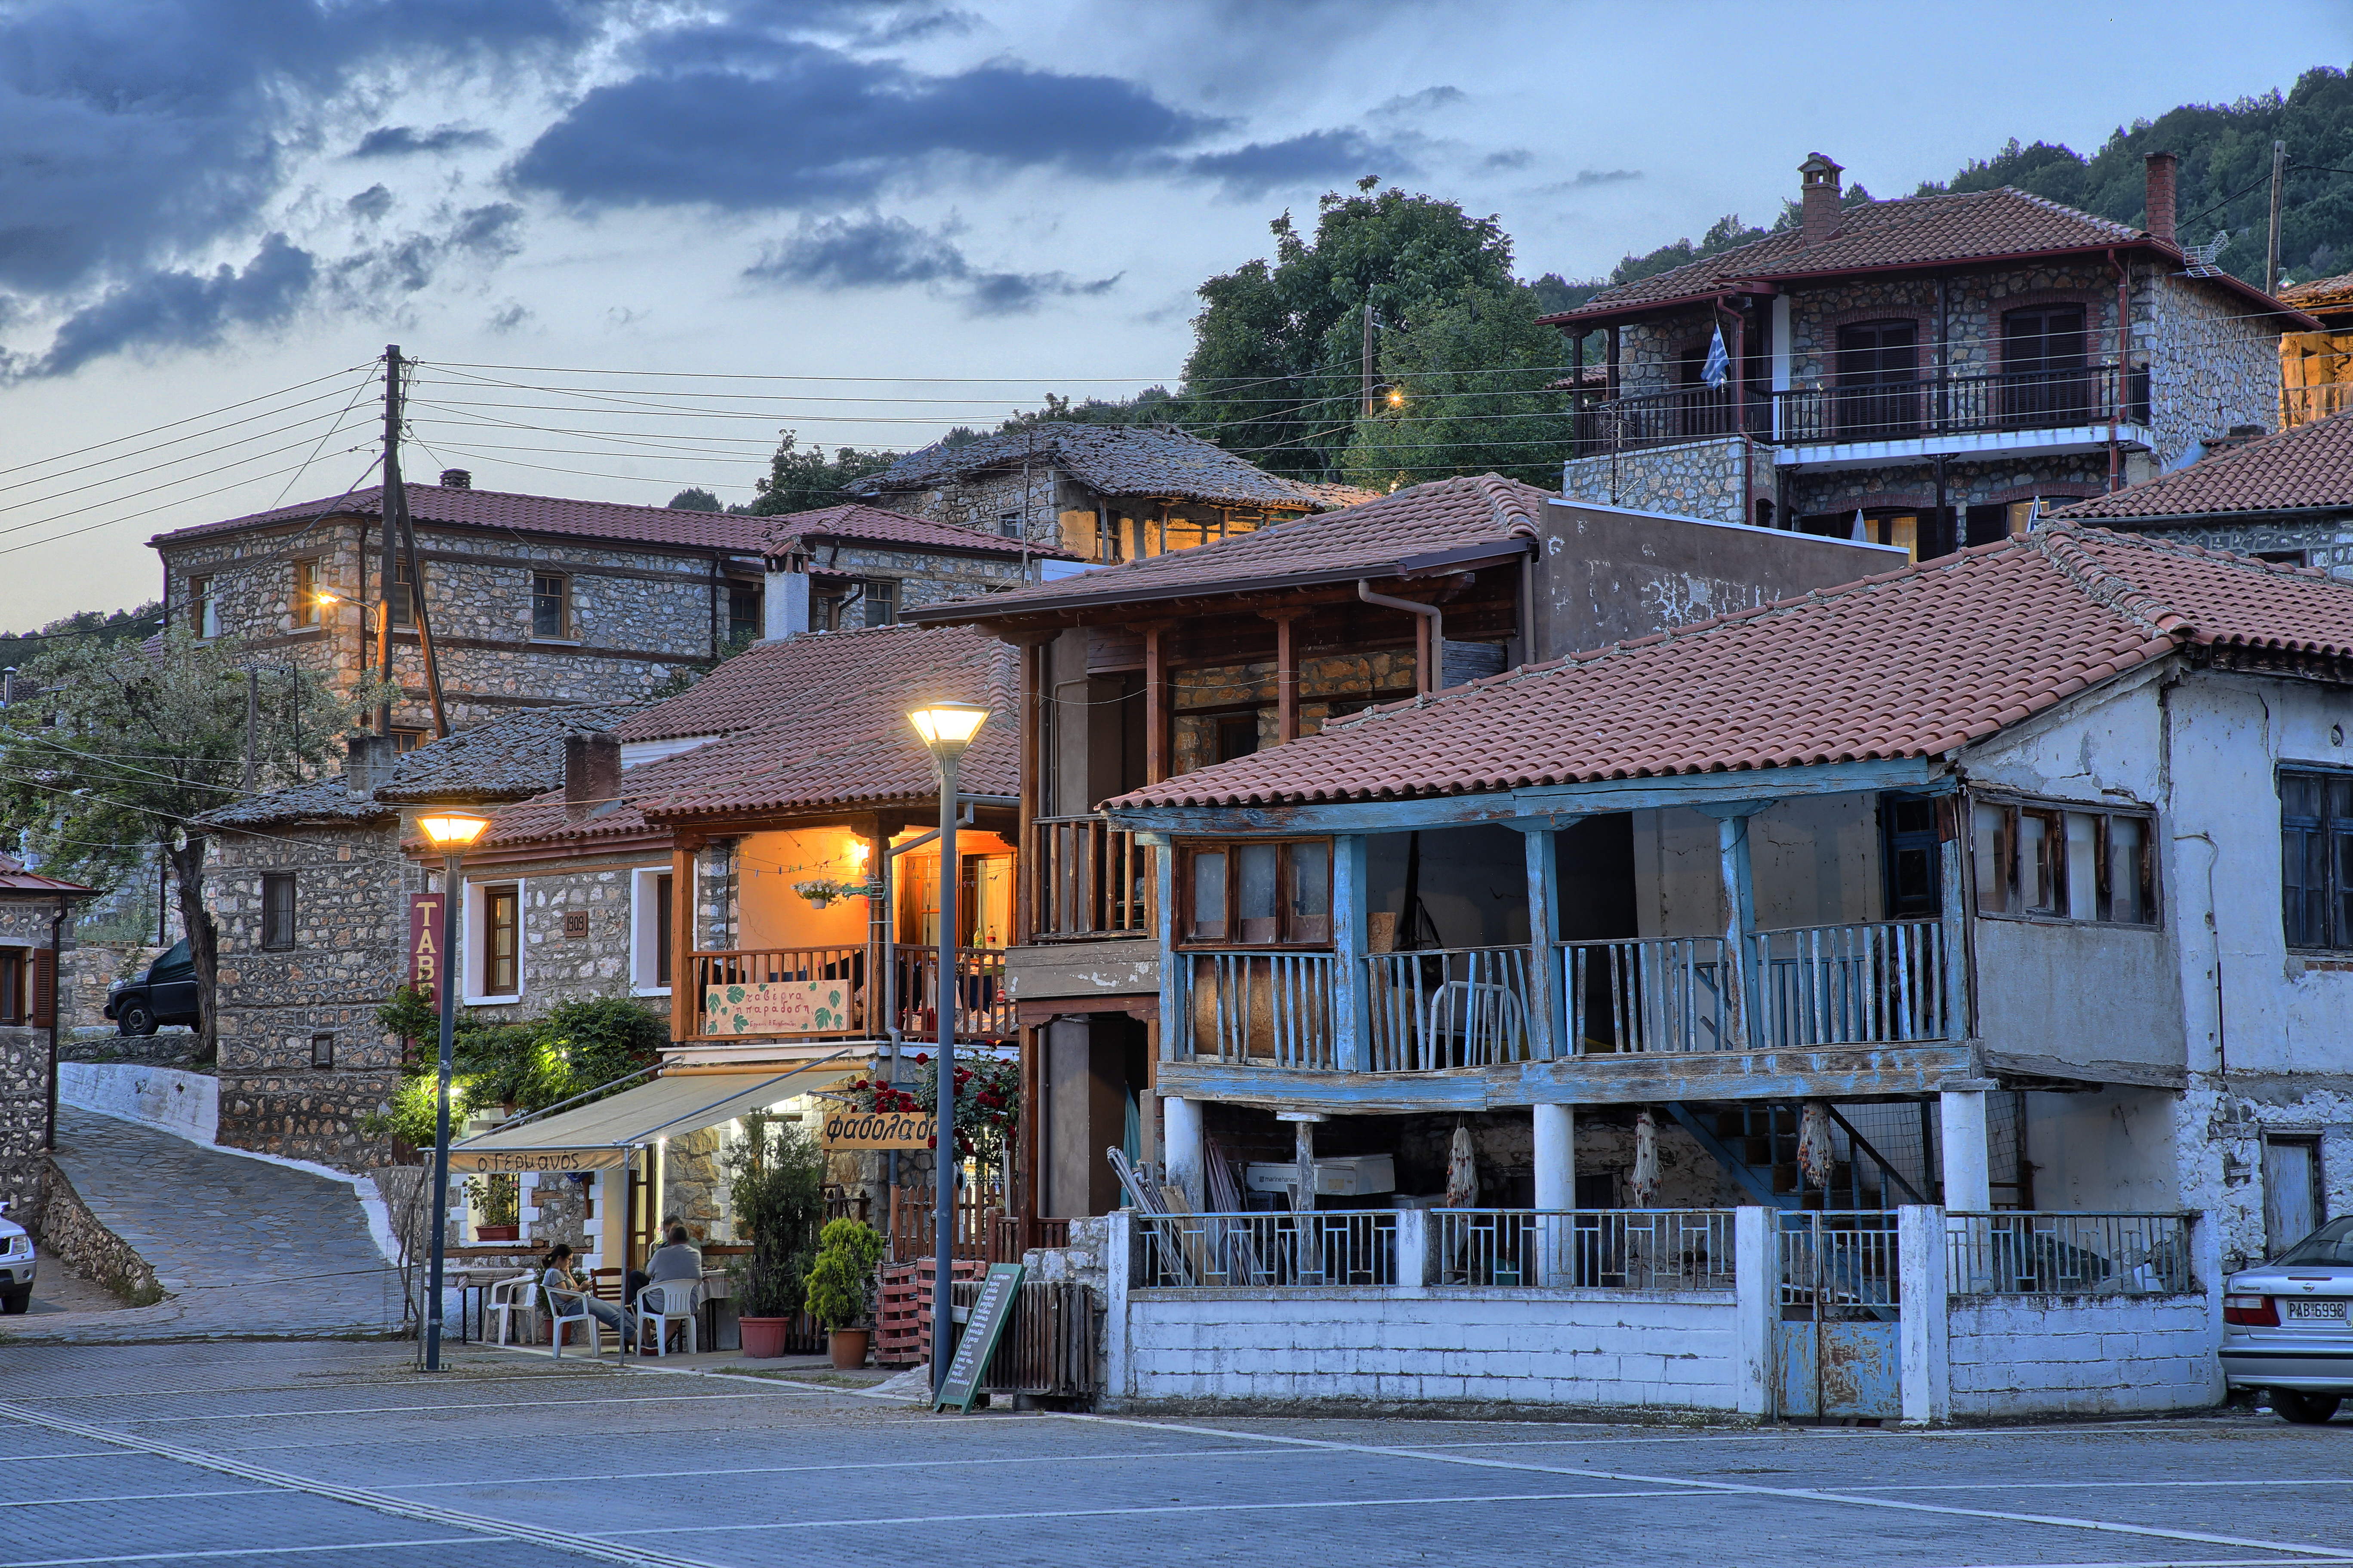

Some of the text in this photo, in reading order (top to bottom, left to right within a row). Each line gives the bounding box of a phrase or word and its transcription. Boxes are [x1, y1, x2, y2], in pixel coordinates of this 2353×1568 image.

[567, 916, 584, 932] 1909
[746, 988, 803, 1004] ταβέρνα
[478, 1150, 579, 1172] ο Γερμανός
